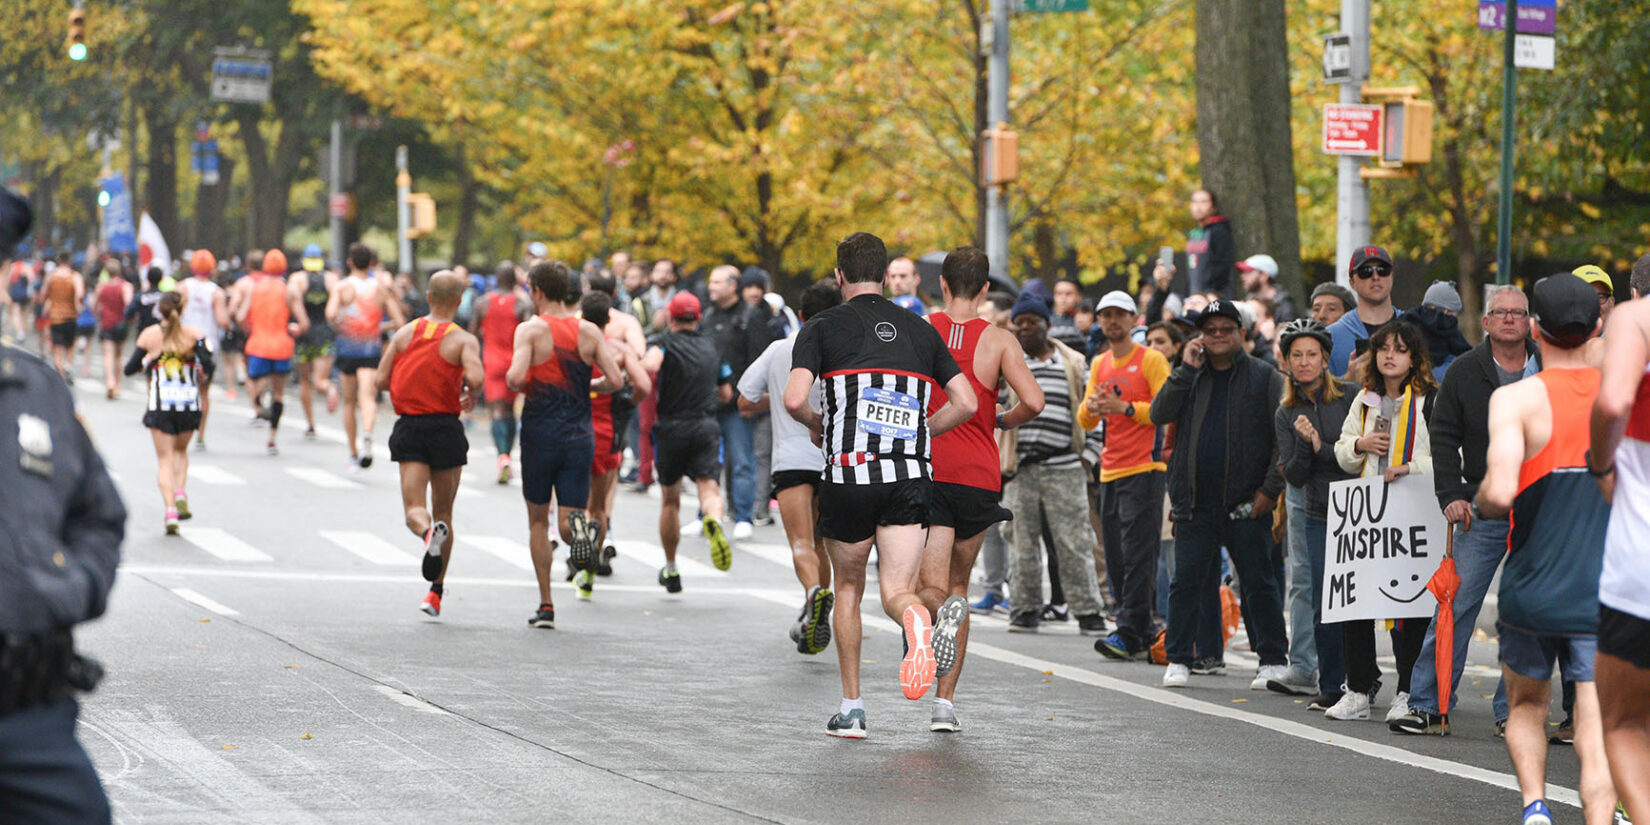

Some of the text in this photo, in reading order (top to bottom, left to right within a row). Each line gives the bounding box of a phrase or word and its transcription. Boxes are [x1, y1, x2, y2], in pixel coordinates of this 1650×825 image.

[866, 403, 911, 427] PETER
[881, 426, 898, 436] 2017
[1332, 482, 1389, 538] YOU
[1336, 525, 1428, 564] INSPIRE
[1328, 570, 1356, 610] ME
